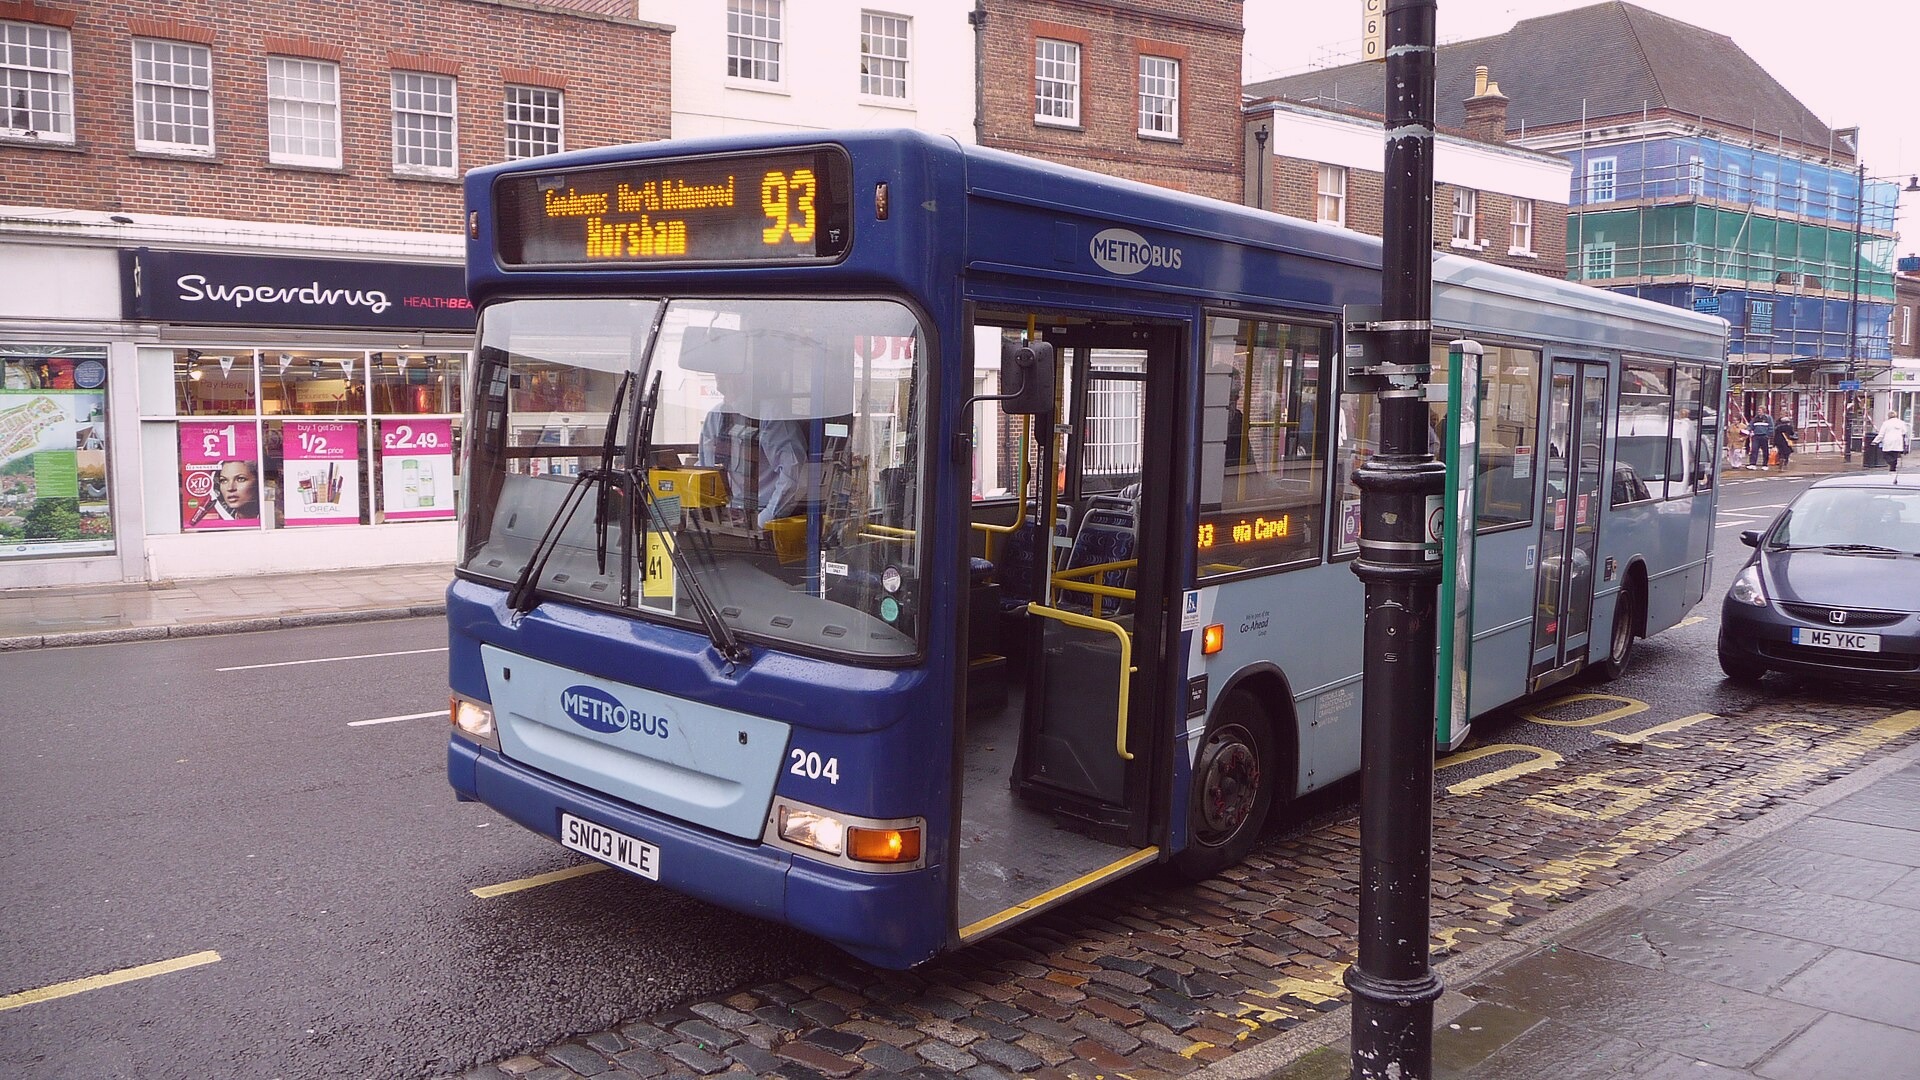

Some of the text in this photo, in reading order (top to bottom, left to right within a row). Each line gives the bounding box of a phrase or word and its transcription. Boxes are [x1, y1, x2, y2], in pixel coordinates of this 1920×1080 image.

[617, 181, 660, 213] North
[762, 168, 817, 245] 93
[586, 213, 687, 258] Horsham
[1093, 237, 1182, 270] METROBUS
[176, 274, 392, 314] Superdrug
[1751, 300, 1773, 315] TRUE
[220, 380, 244, 389] Here
[203, 424, 236, 457] £1
[297, 423, 311, 433] buy
[317, 424, 329, 433] get
[329, 423, 343, 432] 2nd
[384, 425, 437, 449] £2.49
[298, 432, 344, 455] 1/2 price
[1233, 520, 1251, 543] via
[1254, 514, 1288, 540] Capel
[649, 555, 663, 580] 41
[1240, 617, 1270, 633] Go-Ahead
[1811, 631, 1866, 649] M5 YKC
[562, 691, 669, 740] METROBUS
[790, 747, 840, 785] 204
[568, 820, 652, 873] SN03 WLE
